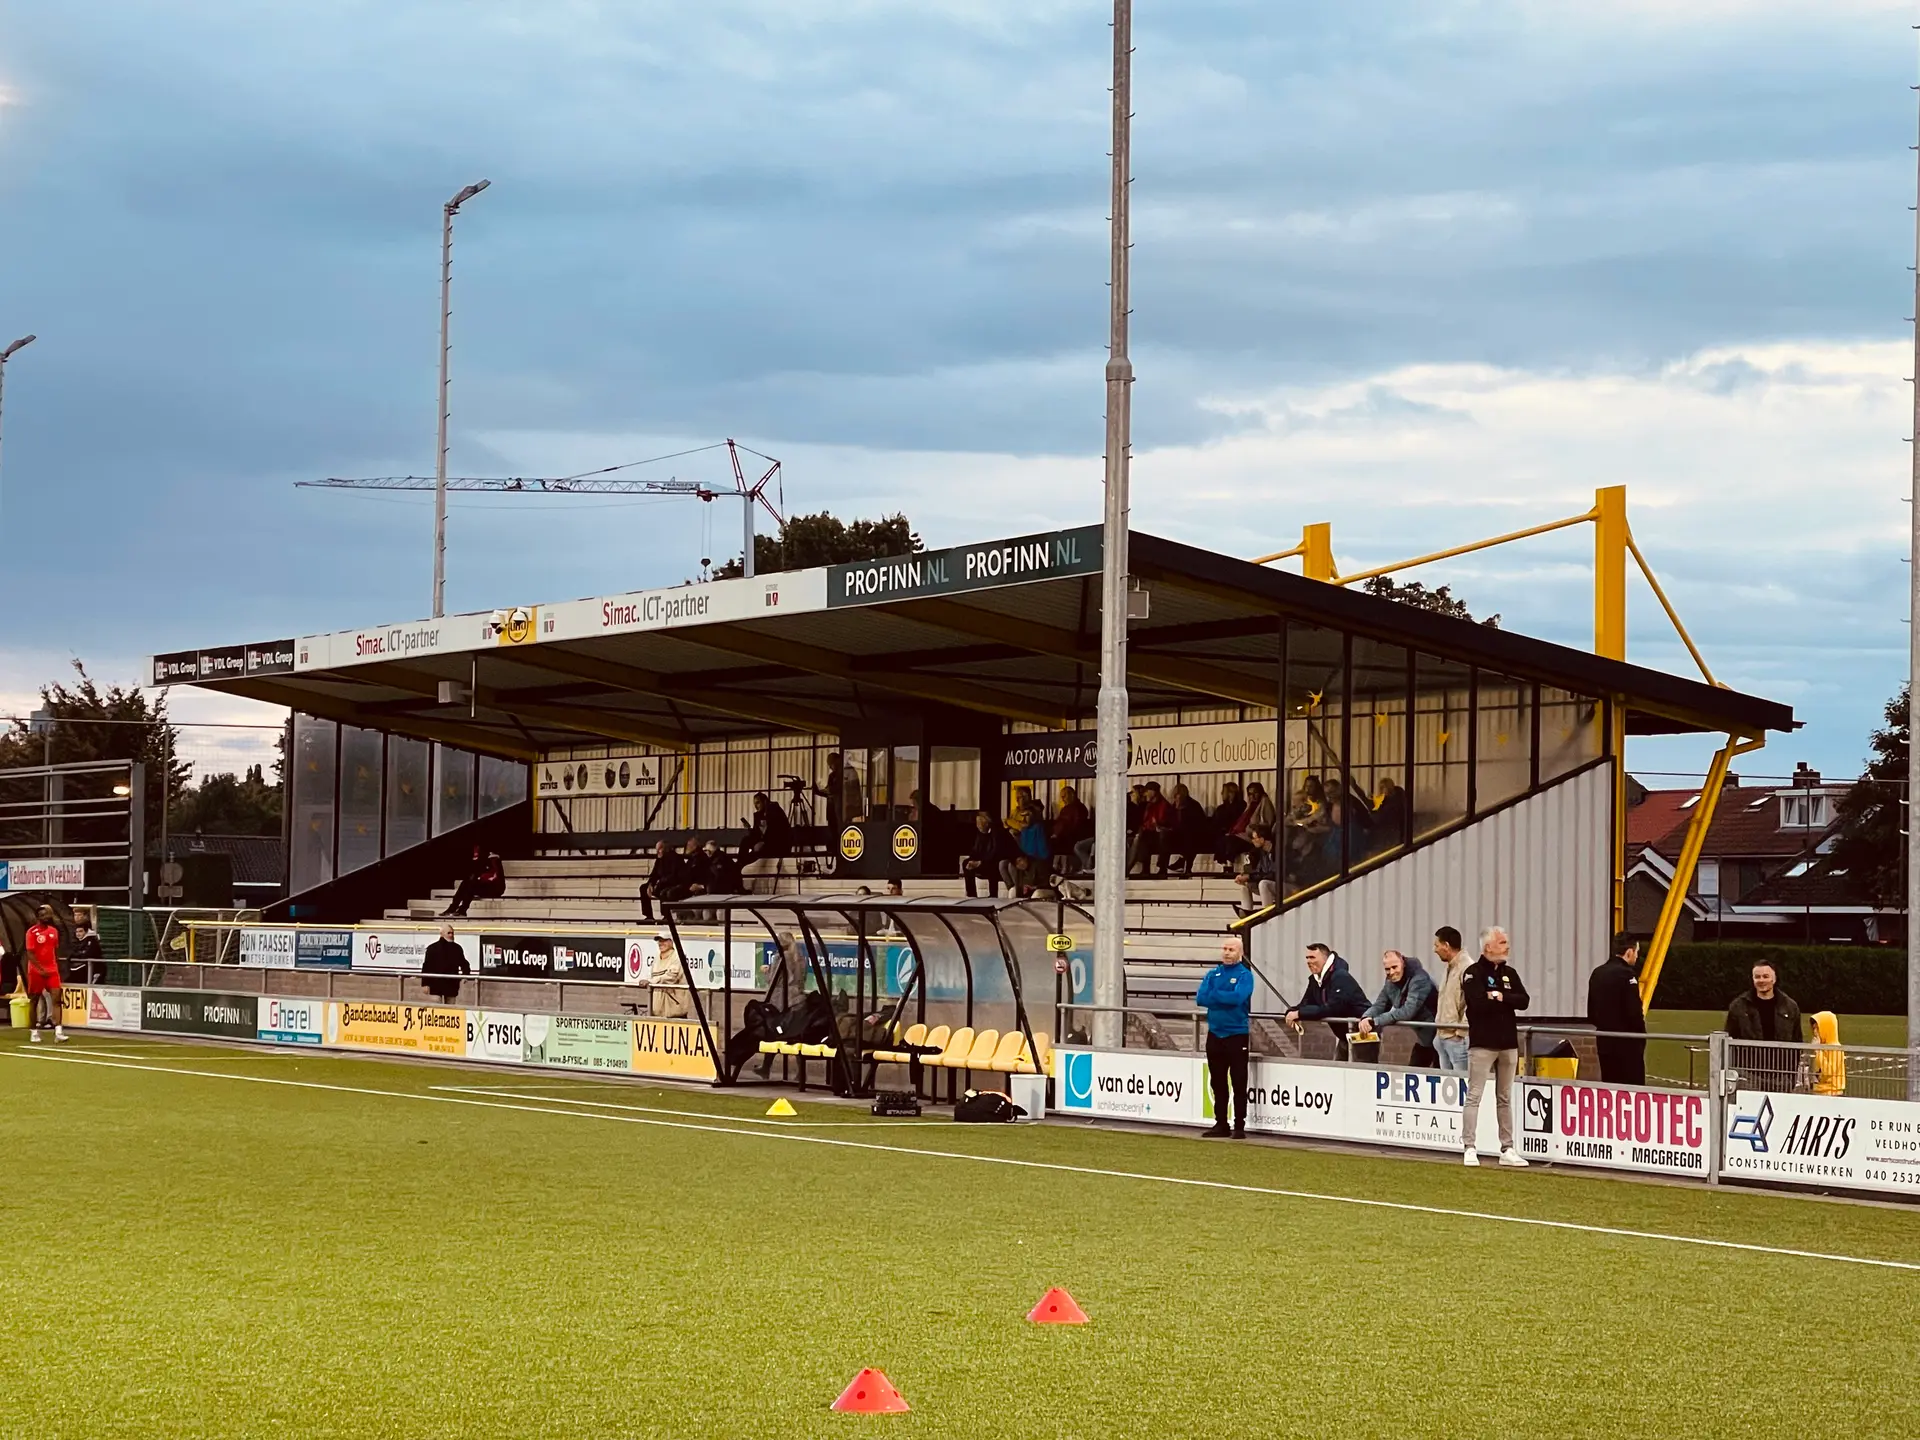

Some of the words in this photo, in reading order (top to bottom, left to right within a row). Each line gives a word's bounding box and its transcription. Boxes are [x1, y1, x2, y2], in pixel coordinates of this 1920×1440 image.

[966, 537, 1081, 580] PROFINN.NL
[845, 558, 950, 596] PROFINN.NL
[643, 594, 709, 627] ICT-partner
[387, 628, 440, 655] ICT-partner
[168, 663, 179, 675] VDL
[180, 662, 197, 676] Groep
[214, 658, 226, 670] VDL
[226, 657, 244, 670] Groep
[262, 652, 275, 665] VDL
[275, 651, 293, 665] Groep
[1004, 746, 1081, 766] MOTORWRAP
[1135, 741, 1176, 766] Avelco
[1180, 742, 1196, 764] ICT
[1200, 741, 1208, 763] &
[1213, 737, 1304, 763] CloudDienen
[241, 933, 256, 951] RON
[259, 934, 294, 952] FAASSEN
[503, 949, 521, 965] VDL
[522, 950, 548, 971] Groep
[575, 951, 594, 967] VDL
[595, 952, 622, 973] Groep
[147, 1002, 192, 1020] PROFINN.NL
[203, 1005, 252, 1025] PROFINN.NL
[270, 1001, 311, 1030] Gherel
[343, 1003, 399, 1027] Bandenhandel
[403, 1007, 415, 1031] A.
[418, 1006, 460, 1031] Tielemans
[467, 1023, 474, 1042] B
[488, 1023, 521, 1045] FYSIC
[556, 1017, 627, 1031] SPORTFYSIOTHERAPIE
[635, 1023, 658, 1053] V.V.
[664, 1025, 709, 1057] U.N.A.
[548, 1055, 588, 1065] www.B-FYSIC.nl
[1098, 1076, 1123, 1093] van
[1127, 1074, 1144, 1094] de
[1148, 1075, 1182, 1102] Looy
[1246, 1087, 1266, 1105] an
[1271, 1084, 1290, 1106] de
[1295, 1085, 1333, 1115] Looy
[1376, 1110, 1456, 1130] METAL
[1561, 1085, 1702, 1149] CARGOTEC
[1871, 1120, 1883, 1131] DE
[1889, 1121, 1911, 1133] RUN
[1779, 1114, 1856, 1160] AARTS
[1875, 1139, 1920, 1151] VELDHO
[1523, 1137, 1548, 1154] HIAB
[1566, 1141, 1613, 1160] KALMAR
[1632, 1147, 1703, 1170] MACGREGOR
[1728, 1156, 1853, 1178] CONSTRUCTIEWERKEN
[1865, 1169, 1887, 1181] 040
